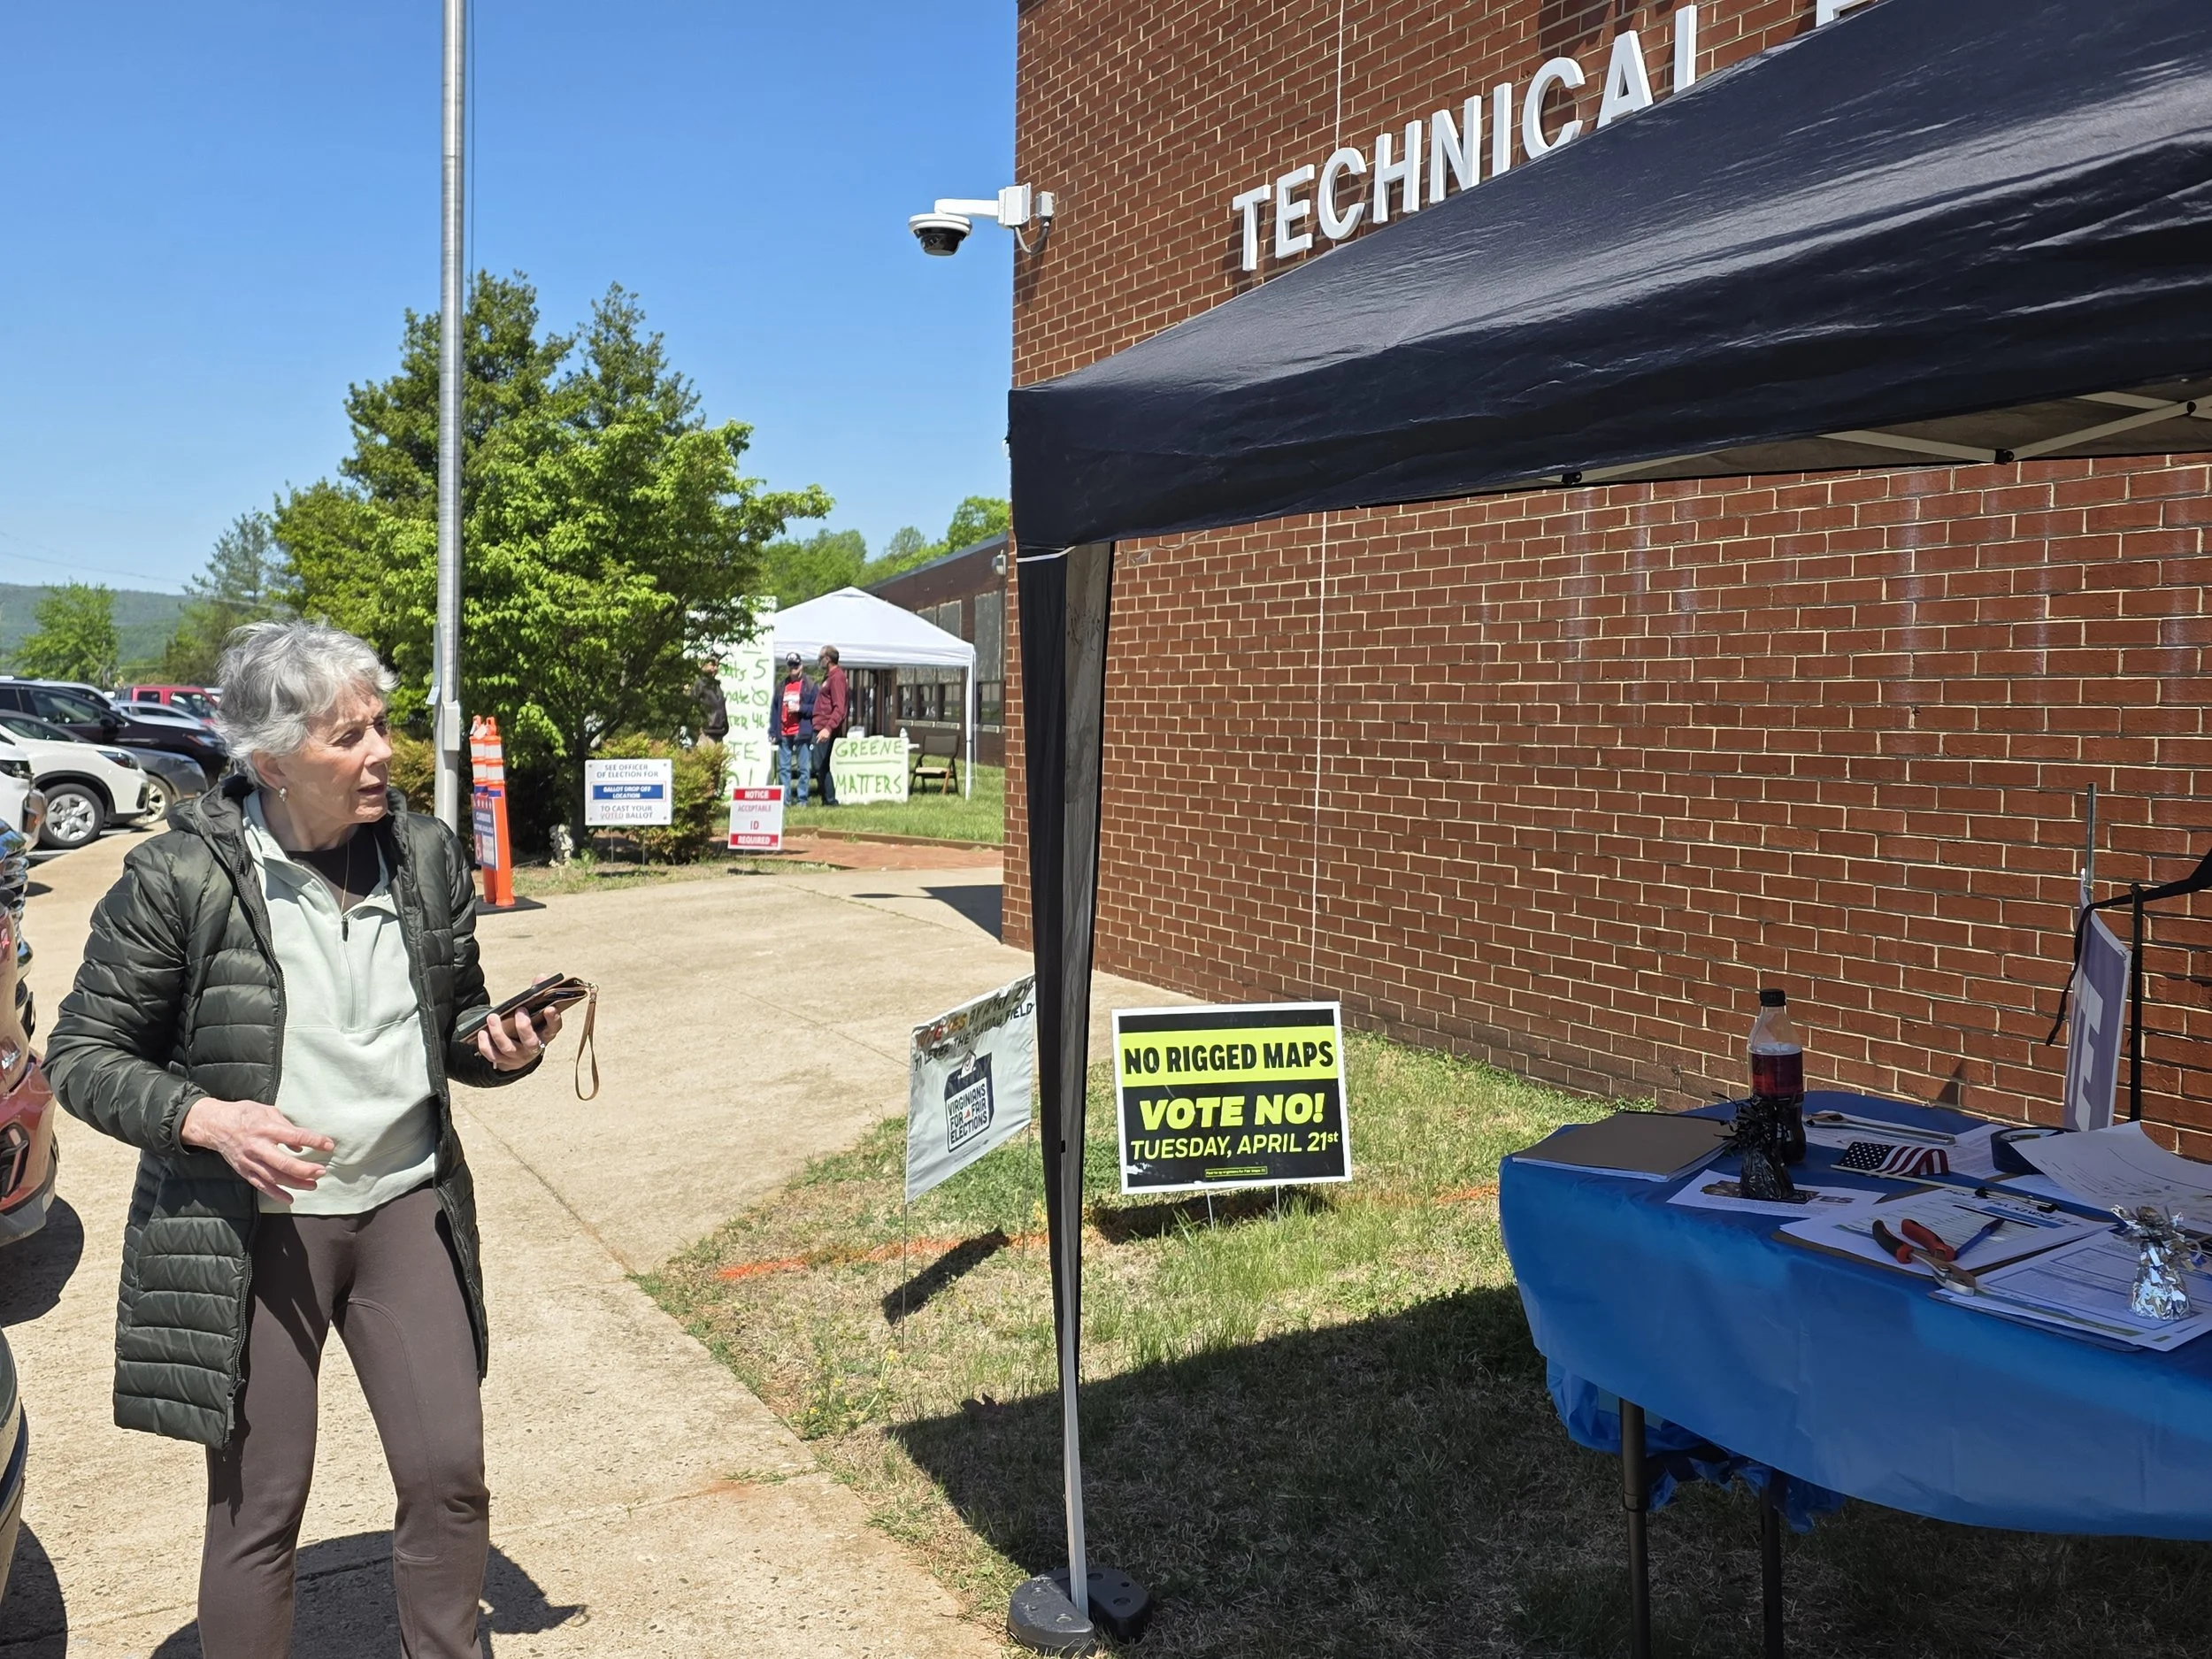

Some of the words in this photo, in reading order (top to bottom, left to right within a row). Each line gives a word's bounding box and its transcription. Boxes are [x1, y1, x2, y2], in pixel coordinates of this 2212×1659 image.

[834, 739, 905, 757] GREENE
[744, 790, 770, 799] NOTICE
[835, 773, 902, 795] MATTERS
[737, 835, 771, 845] REQUIRED
[749, 820, 759, 830] ID
[953, 1031, 972, 1048] THE
[1004, 1002, 1035, 1024] FIELD
[1124, 1047, 1161, 1075] NO
[1165, 1043, 1258, 1072] RIGGED
[1263, 1040, 1334, 1070] MAPS
[948, 1083, 987, 1117] VIRGINIANS
[949, 1110, 964, 1132] FOR
[971, 1097, 987, 1118] FAIR
[1139, 1094, 1246, 1132] VOTE
[1254, 1092, 1325, 1126] NO!
[950, 1110, 987, 1145] ELECTIONS
[1130, 1134, 1233, 1161] TUESDAY,
[1236, 1132, 1302, 1156] APRIL
[1306, 1130, 1340, 1152] 21st
